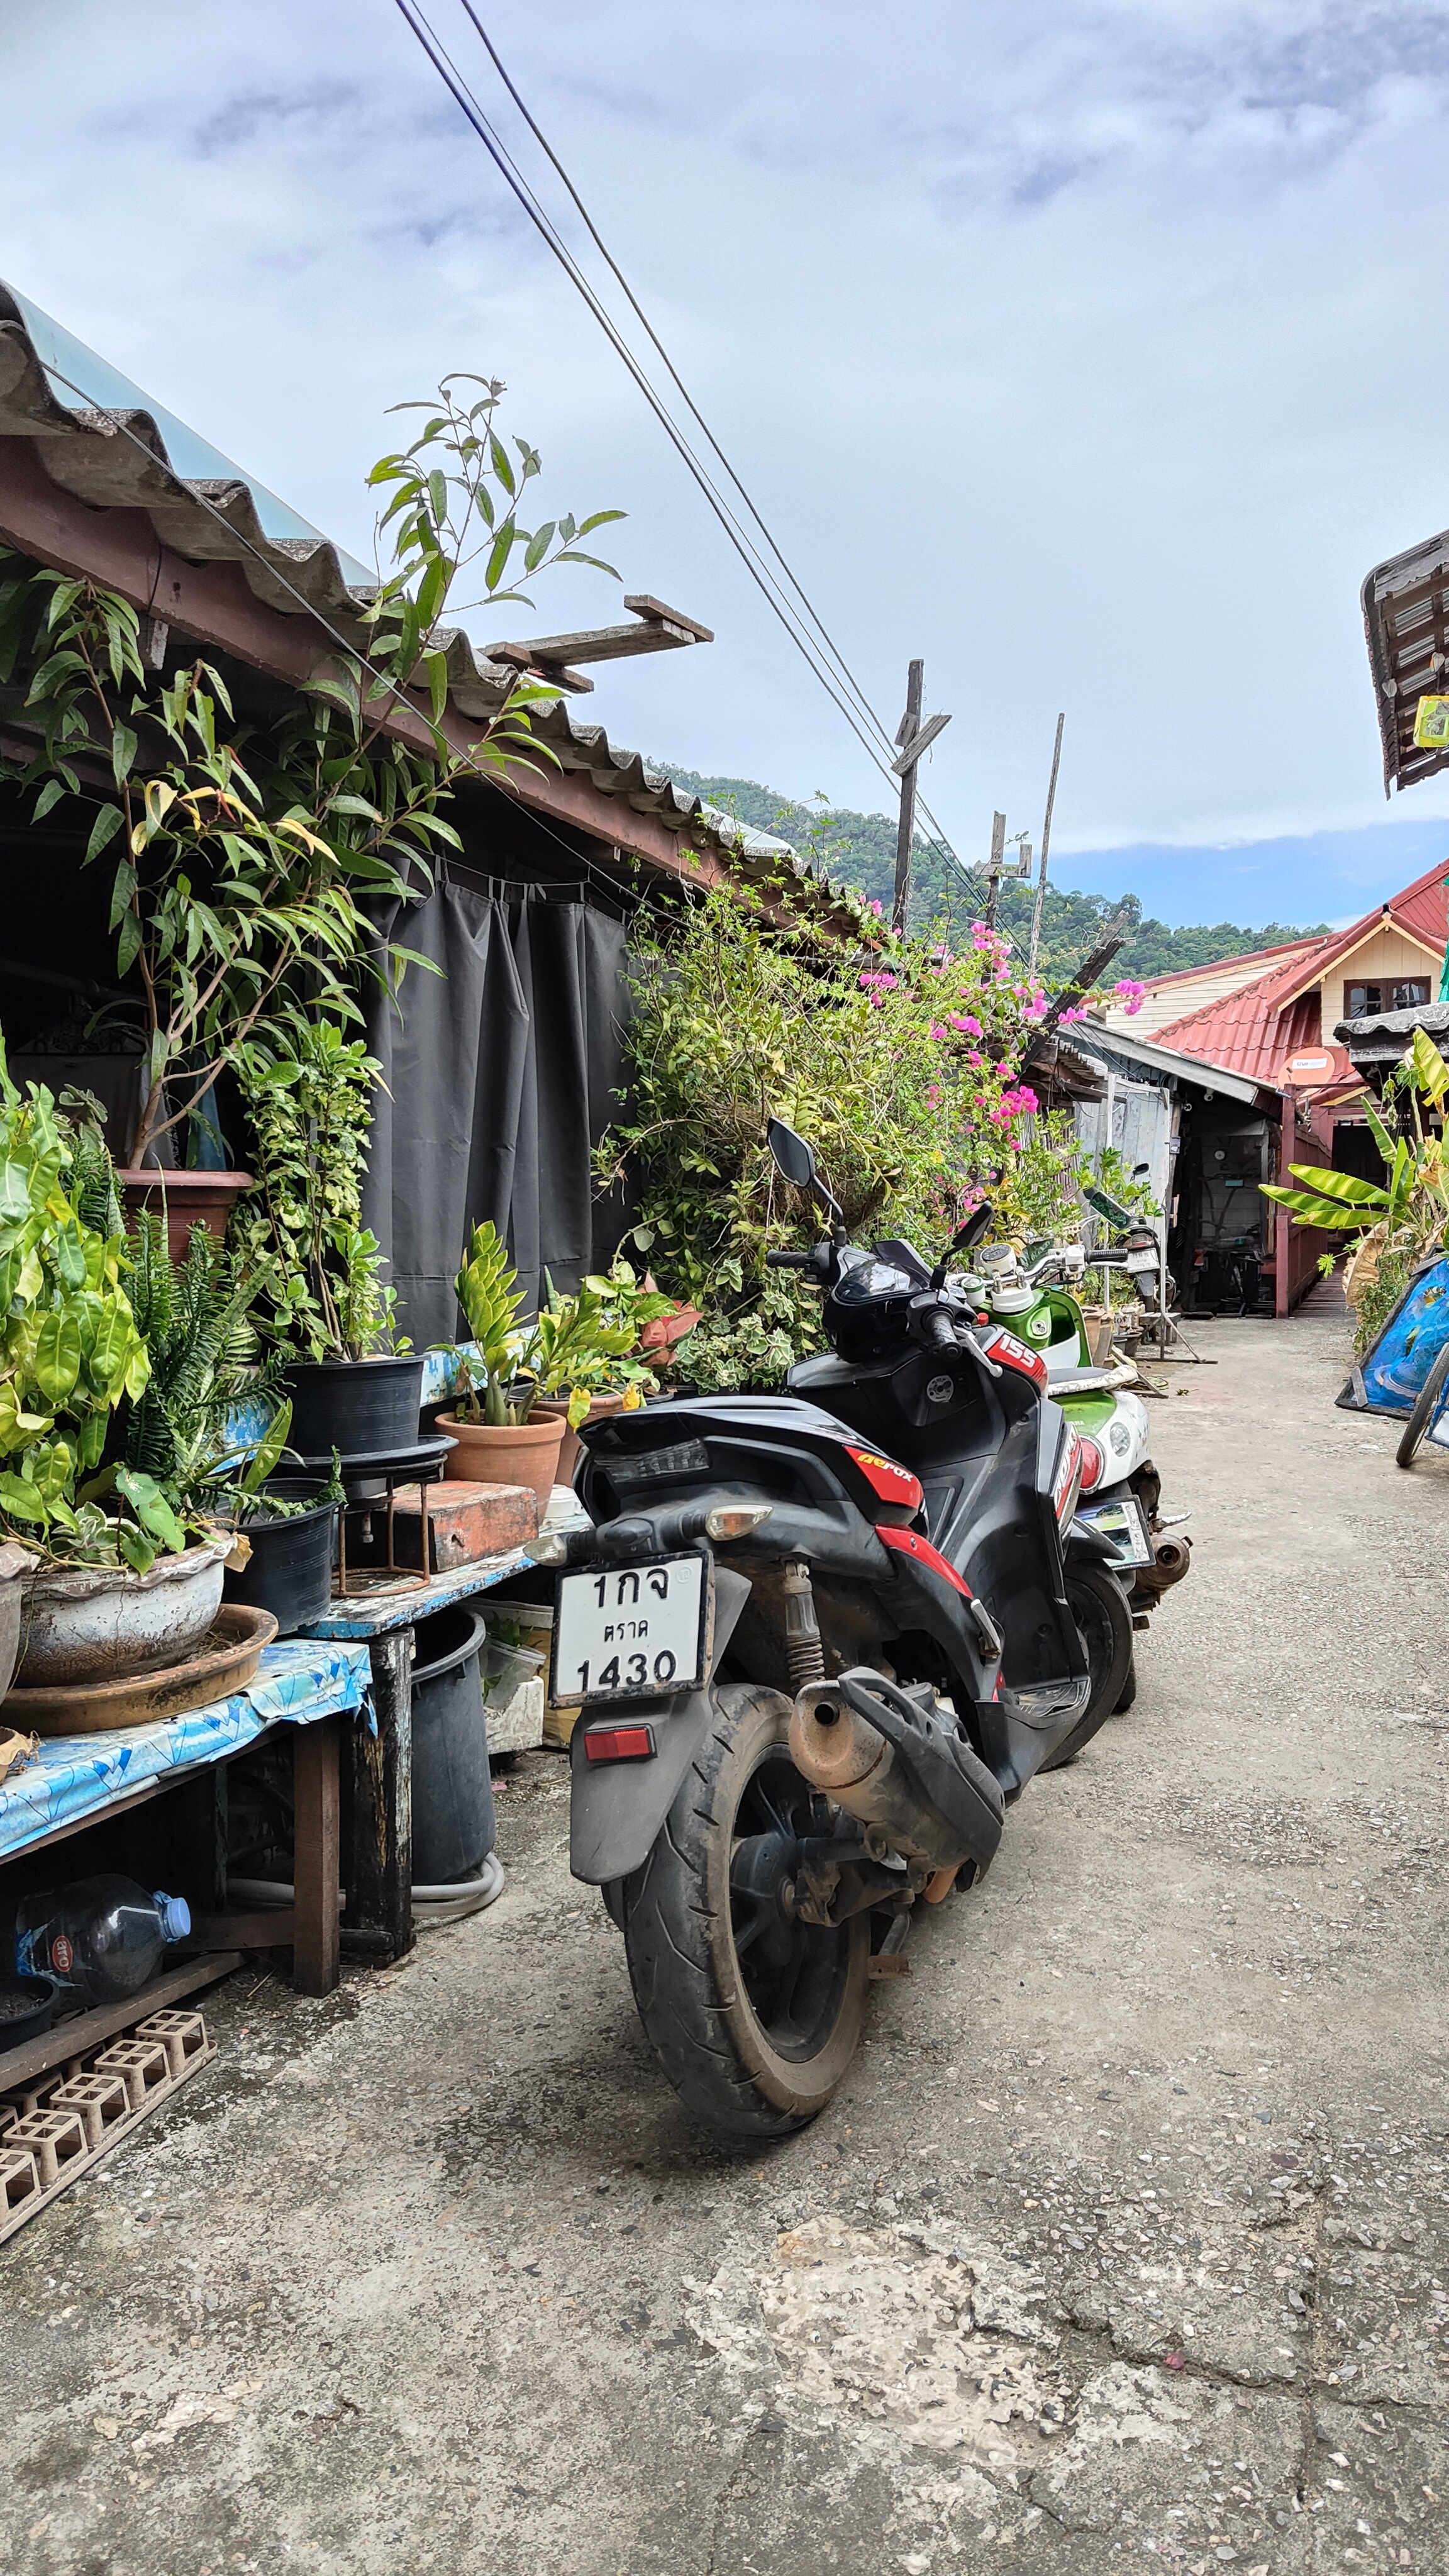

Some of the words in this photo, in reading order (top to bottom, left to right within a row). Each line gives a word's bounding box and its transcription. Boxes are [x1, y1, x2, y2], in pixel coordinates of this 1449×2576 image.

[999, 1334, 1038, 1368] 155
[594, 1568, 670, 1608] 1กจ
[604, 1619, 649, 1643] ตราด
[577, 1650, 677, 1692] 1430
[57, 1941, 69, 1967] aro
